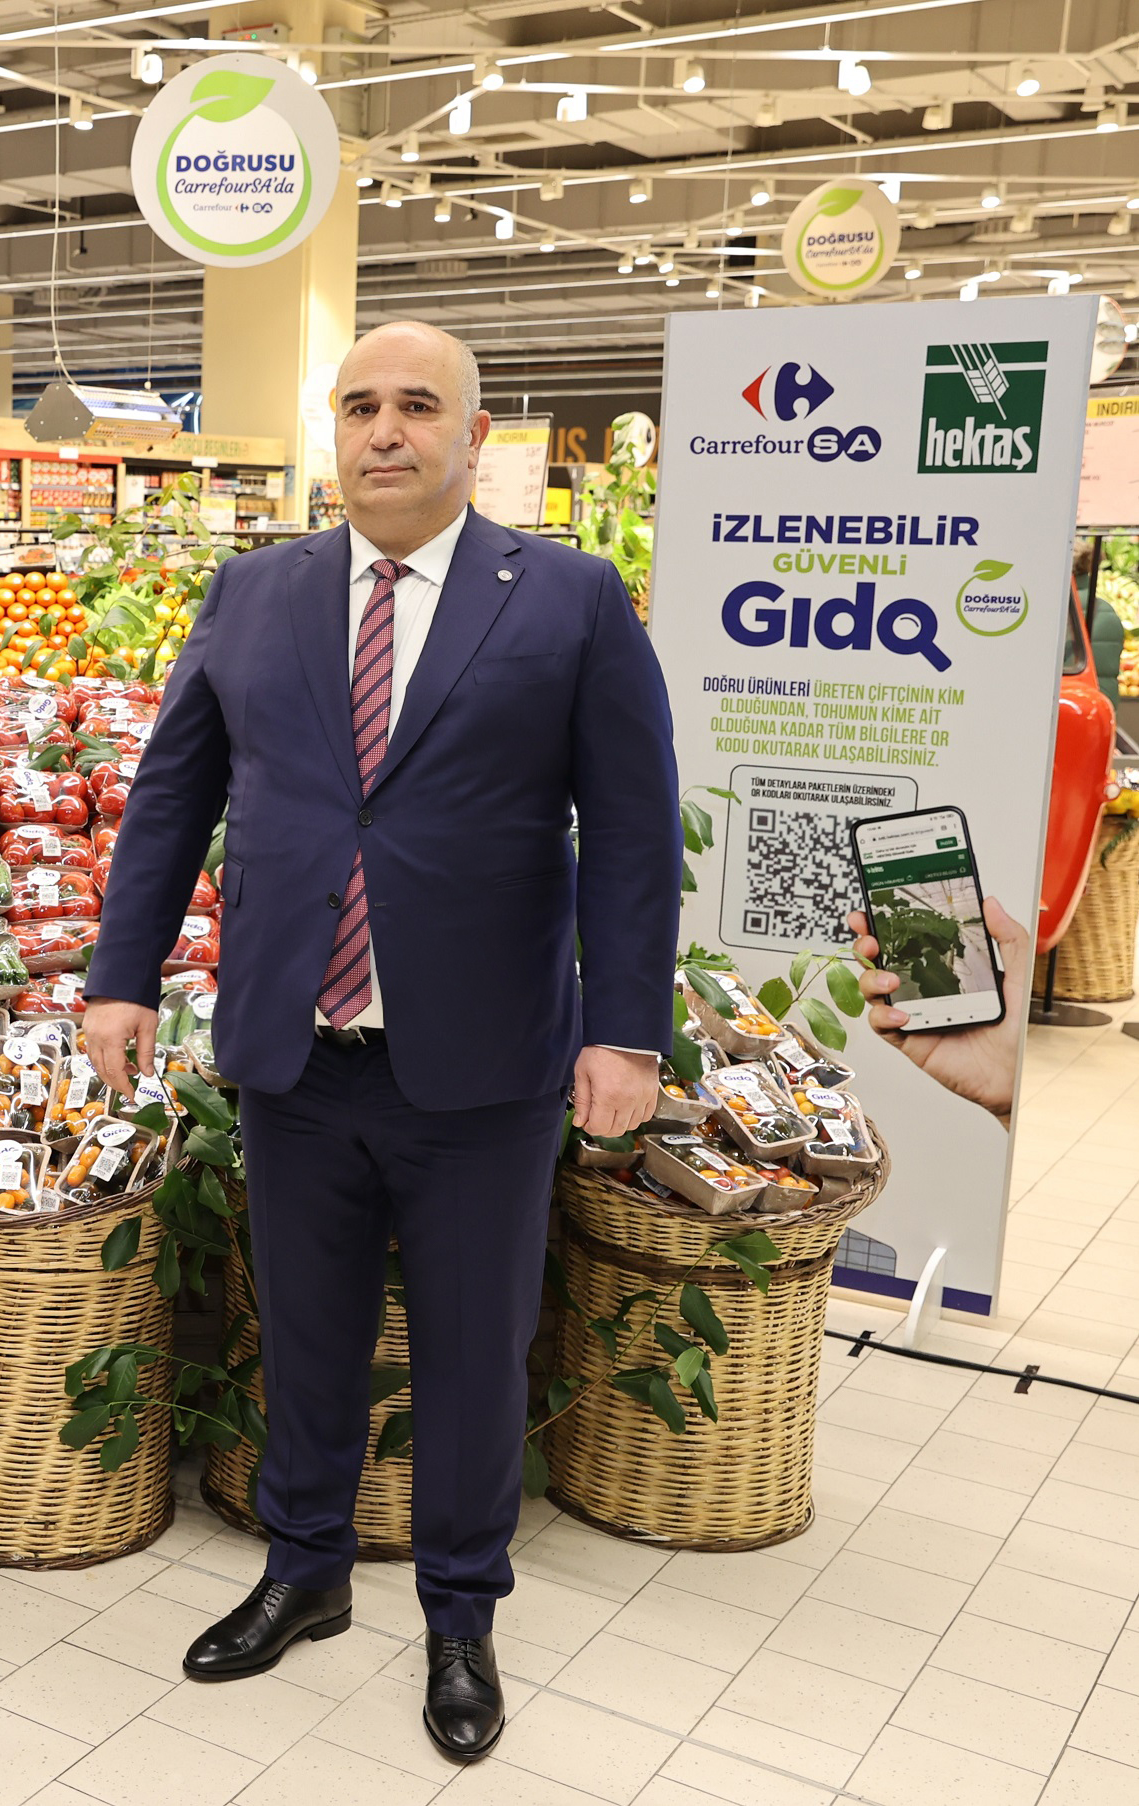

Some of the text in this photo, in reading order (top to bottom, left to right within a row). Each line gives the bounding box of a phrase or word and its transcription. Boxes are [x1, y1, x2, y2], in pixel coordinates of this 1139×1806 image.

[176, 150, 295, 173] DOĞRUSU
[174, 177, 294, 196] CarrefourSA'da
[193, 203, 232, 212] Carrefour
[807, 231, 874, 247] DOĞRUSU
[1097, 397, 1139, 417] INDIRI
[925, 417, 1034, 471] hektaş
[964, 593, 1022, 605] DOĞRUSU
[703, 675, 964, 705] DOĞRU ÜRÜNLERİ ÜRETEN ÇİFTÇİNİN KİM
[721, 695, 941, 725] OLDUĞUNDAN, TOHUMUN KİME AİT
[711, 714, 949, 746] OLDUĞUNA KADAR TÜM BİLGİLERE QR
[716, 736, 939, 767] KODU OKUTARAK ULAŞABİLİRSİNİZ.
[751, 777, 895, 797] TÜM DETAYLARA PAKETLERİN ÜZERİNDEKİ
[751, 789, 893, 808] QR KODLARI OKUTARAK ULAŞABİLİRSİNİZ.
